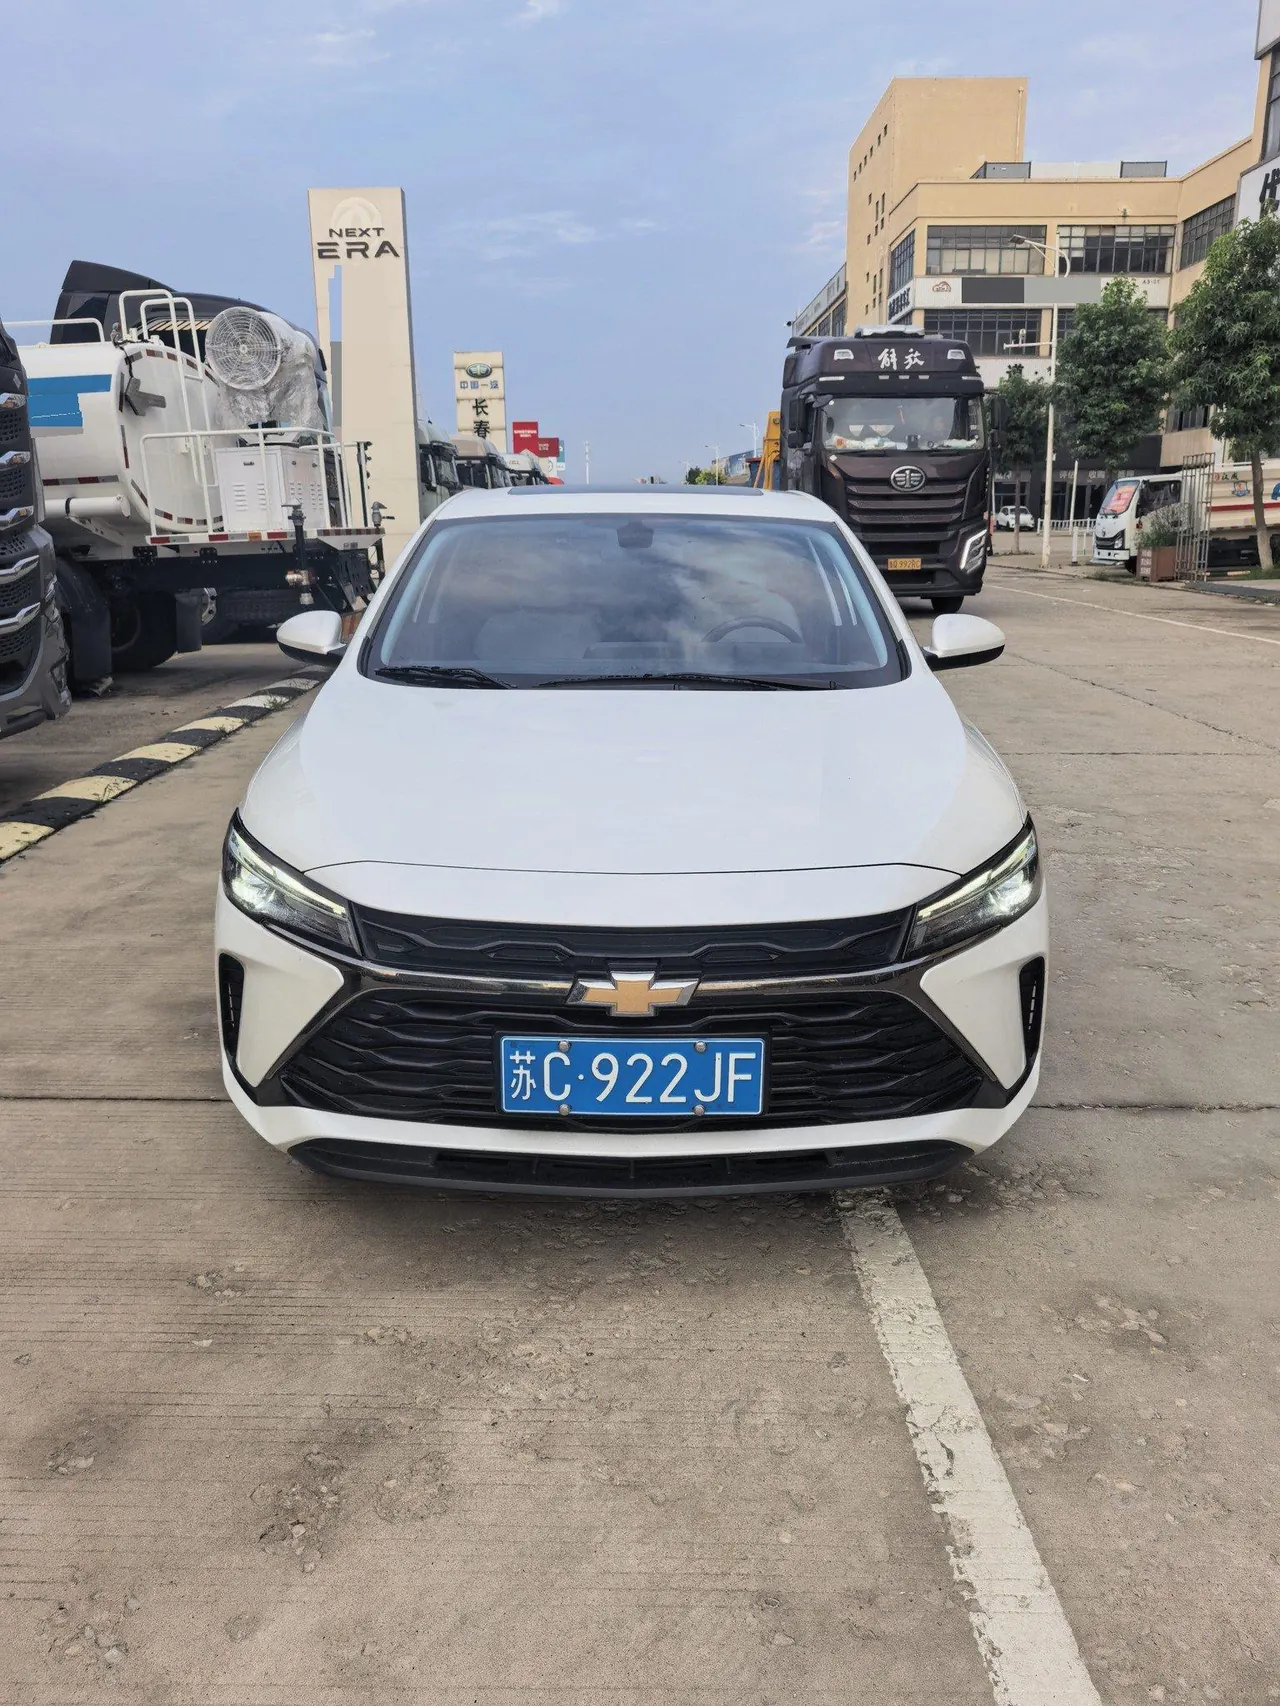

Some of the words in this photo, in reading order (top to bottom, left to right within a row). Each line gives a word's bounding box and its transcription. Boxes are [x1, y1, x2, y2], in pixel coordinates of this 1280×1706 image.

[329, 228, 385, 238] NEXT
[317, 240, 400, 259] ERA
[877, 347, 925, 370] 解放
[472, 399, 490, 439] 长春
[509, 1050, 757, 1103] 苏C·922JF
